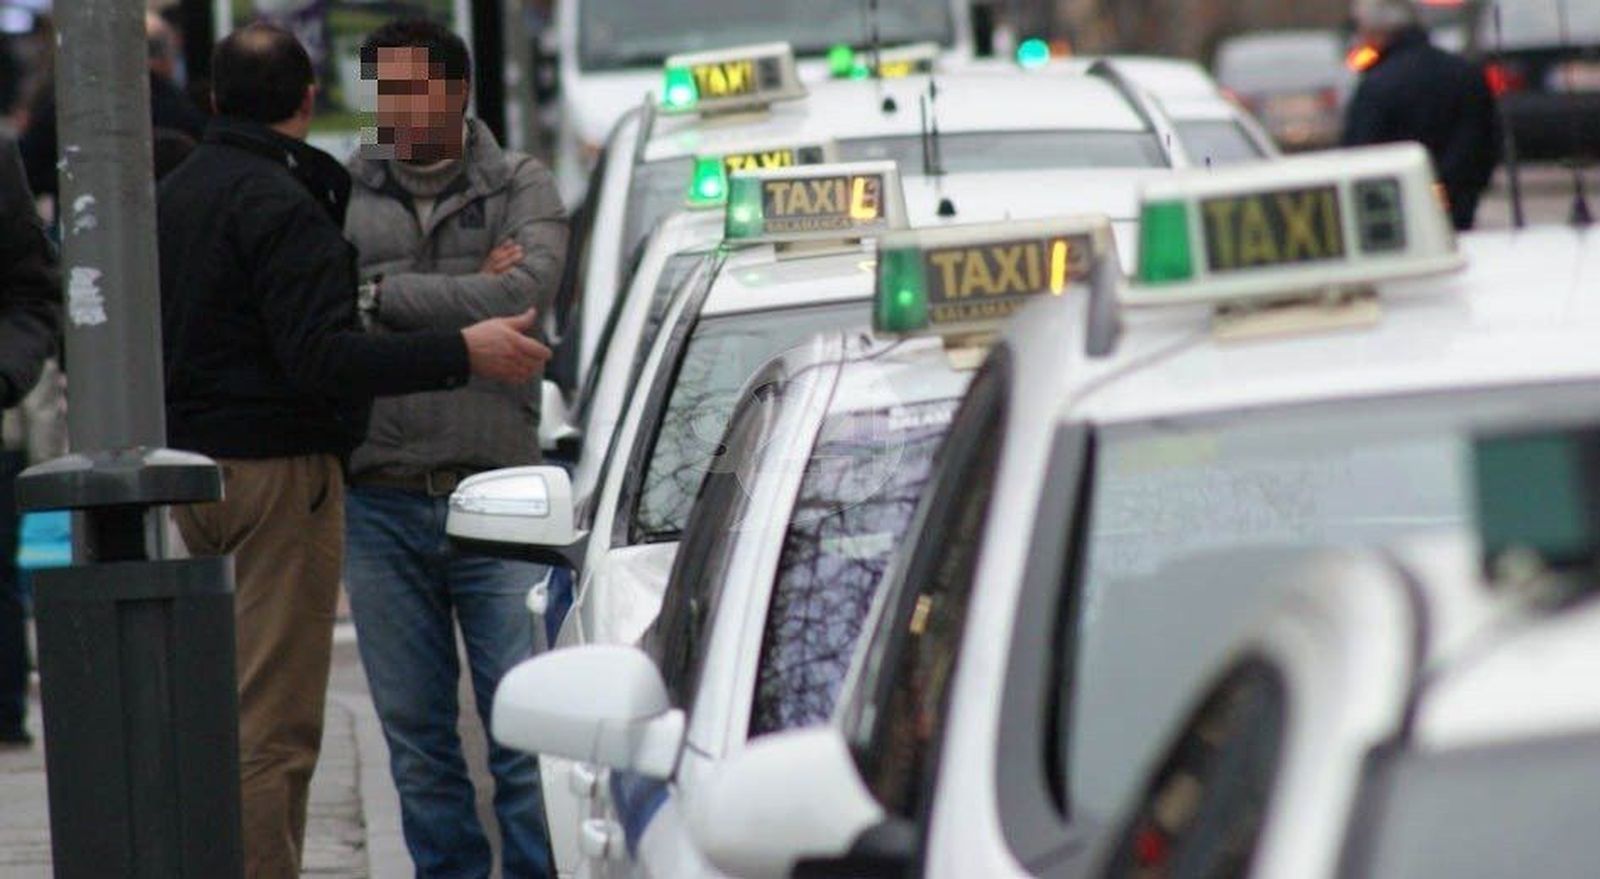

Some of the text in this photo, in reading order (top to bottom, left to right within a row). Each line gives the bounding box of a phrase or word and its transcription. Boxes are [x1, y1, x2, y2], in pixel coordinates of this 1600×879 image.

[694, 61, 751, 96] TAXI
[766, 180, 845, 215] TAXI
[1204, 190, 1341, 268] TAXI
[931, 243, 1040, 299] TAXI
